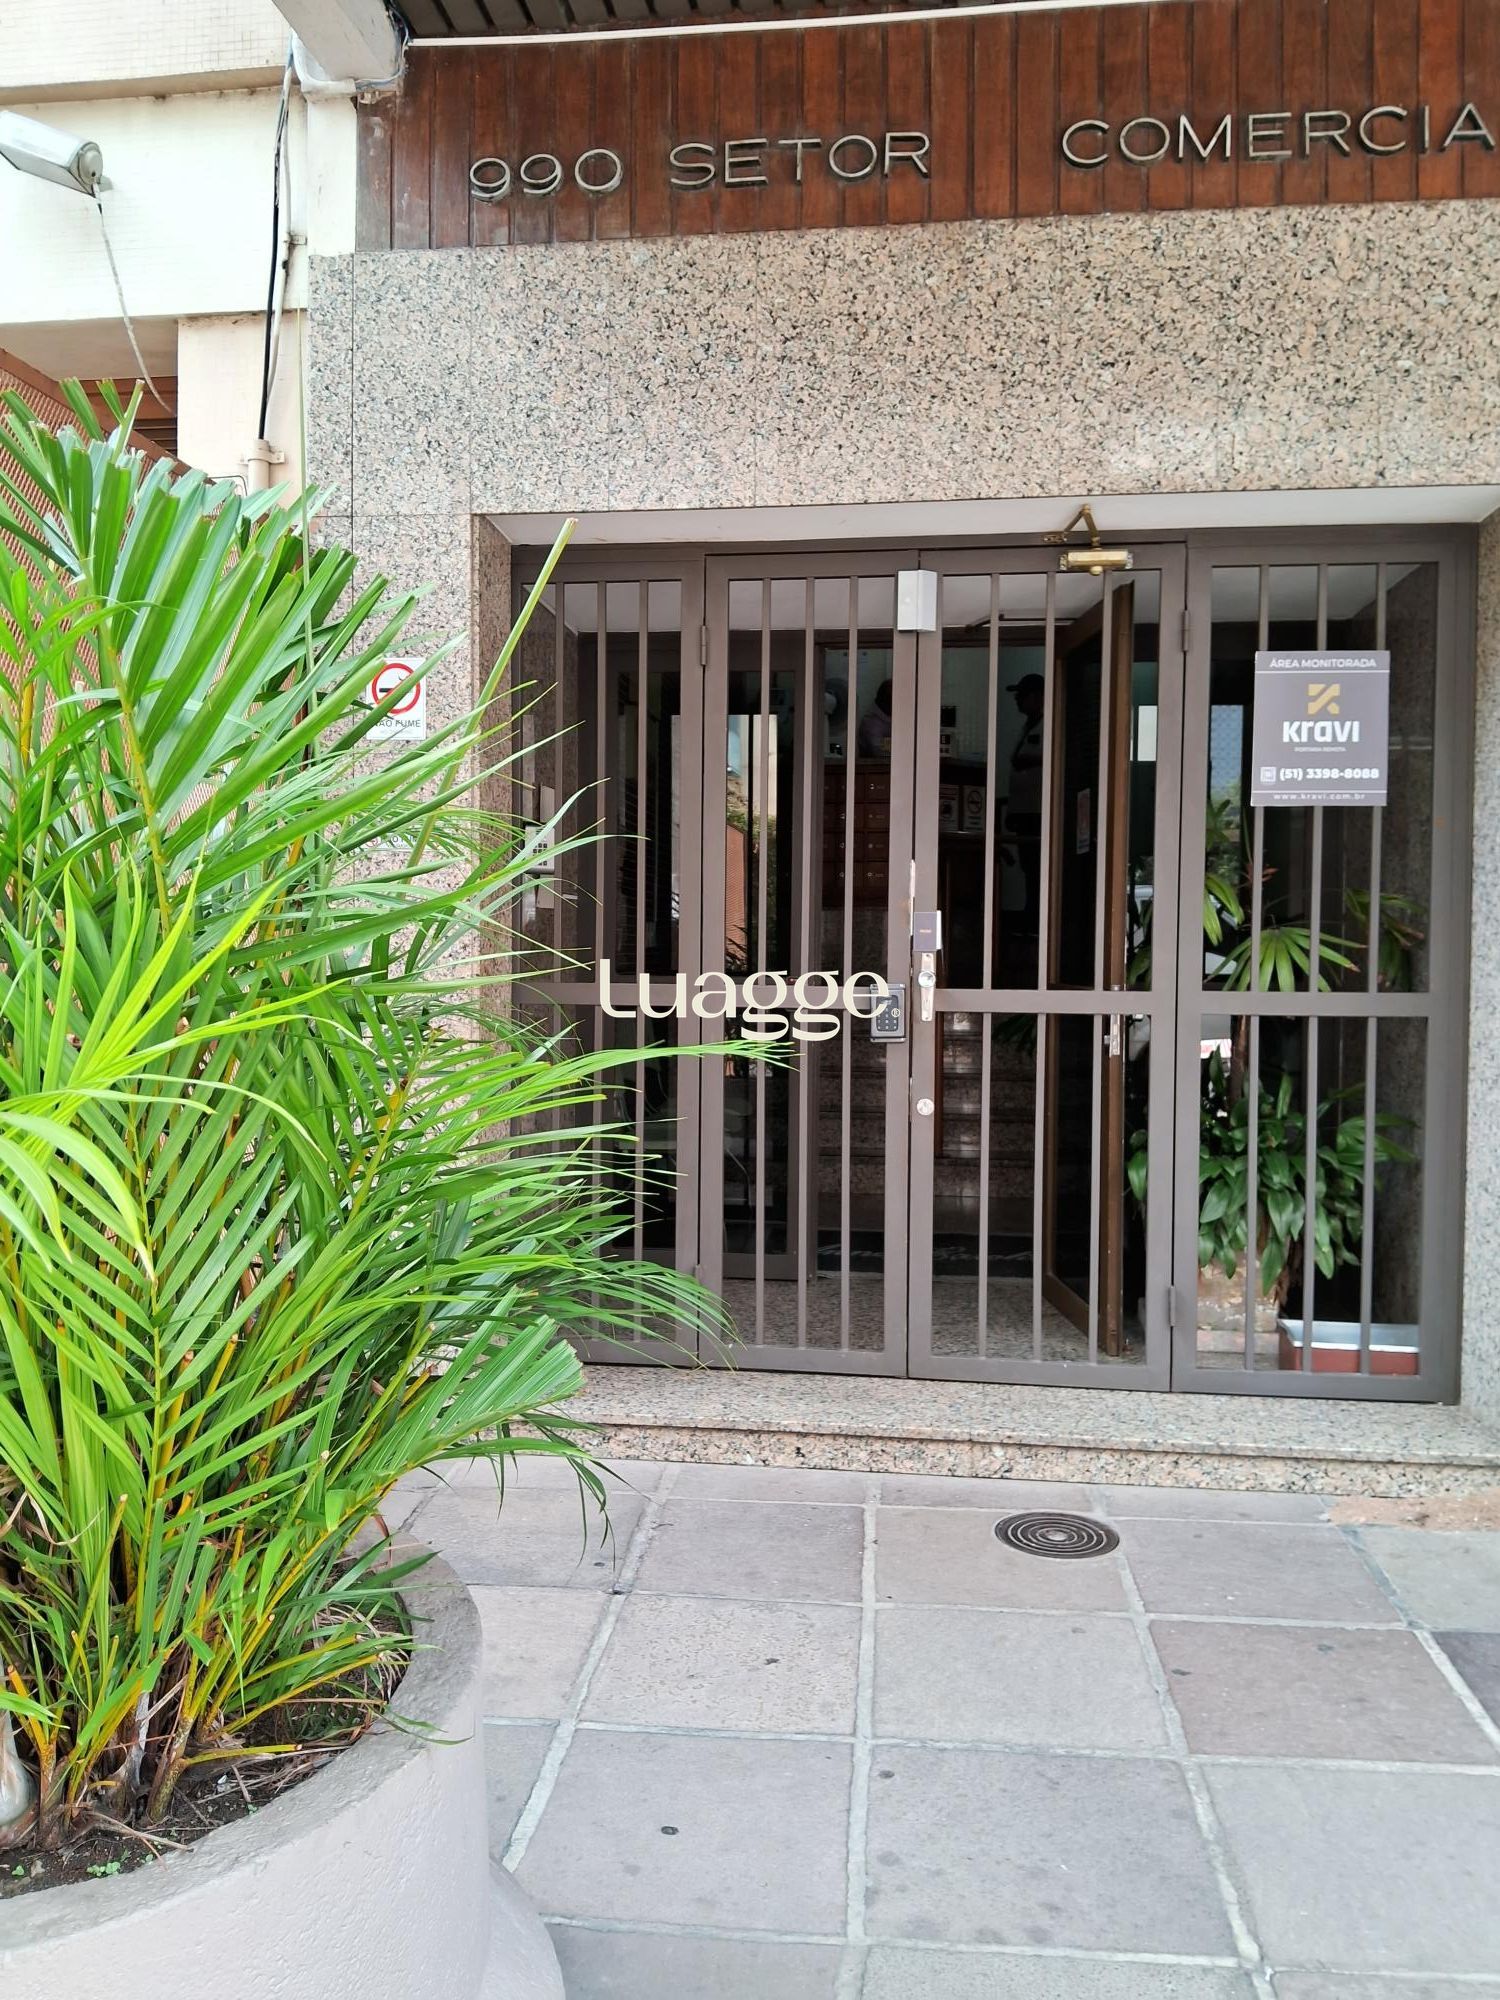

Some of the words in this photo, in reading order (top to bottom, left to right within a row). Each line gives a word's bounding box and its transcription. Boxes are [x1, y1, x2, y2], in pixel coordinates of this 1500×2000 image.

[469, 147, 624, 201] 990
[669, 131, 931, 188] SETOR
[1062, 102, 1496, 168] COMERCIA
[1301, 658, 1377, 668] MONITORADA
[395, 719, 421, 728] FUME
[1280, 767, 1303, 781] (51)
[1273, 793, 1366, 801] www.kravi.com.br
